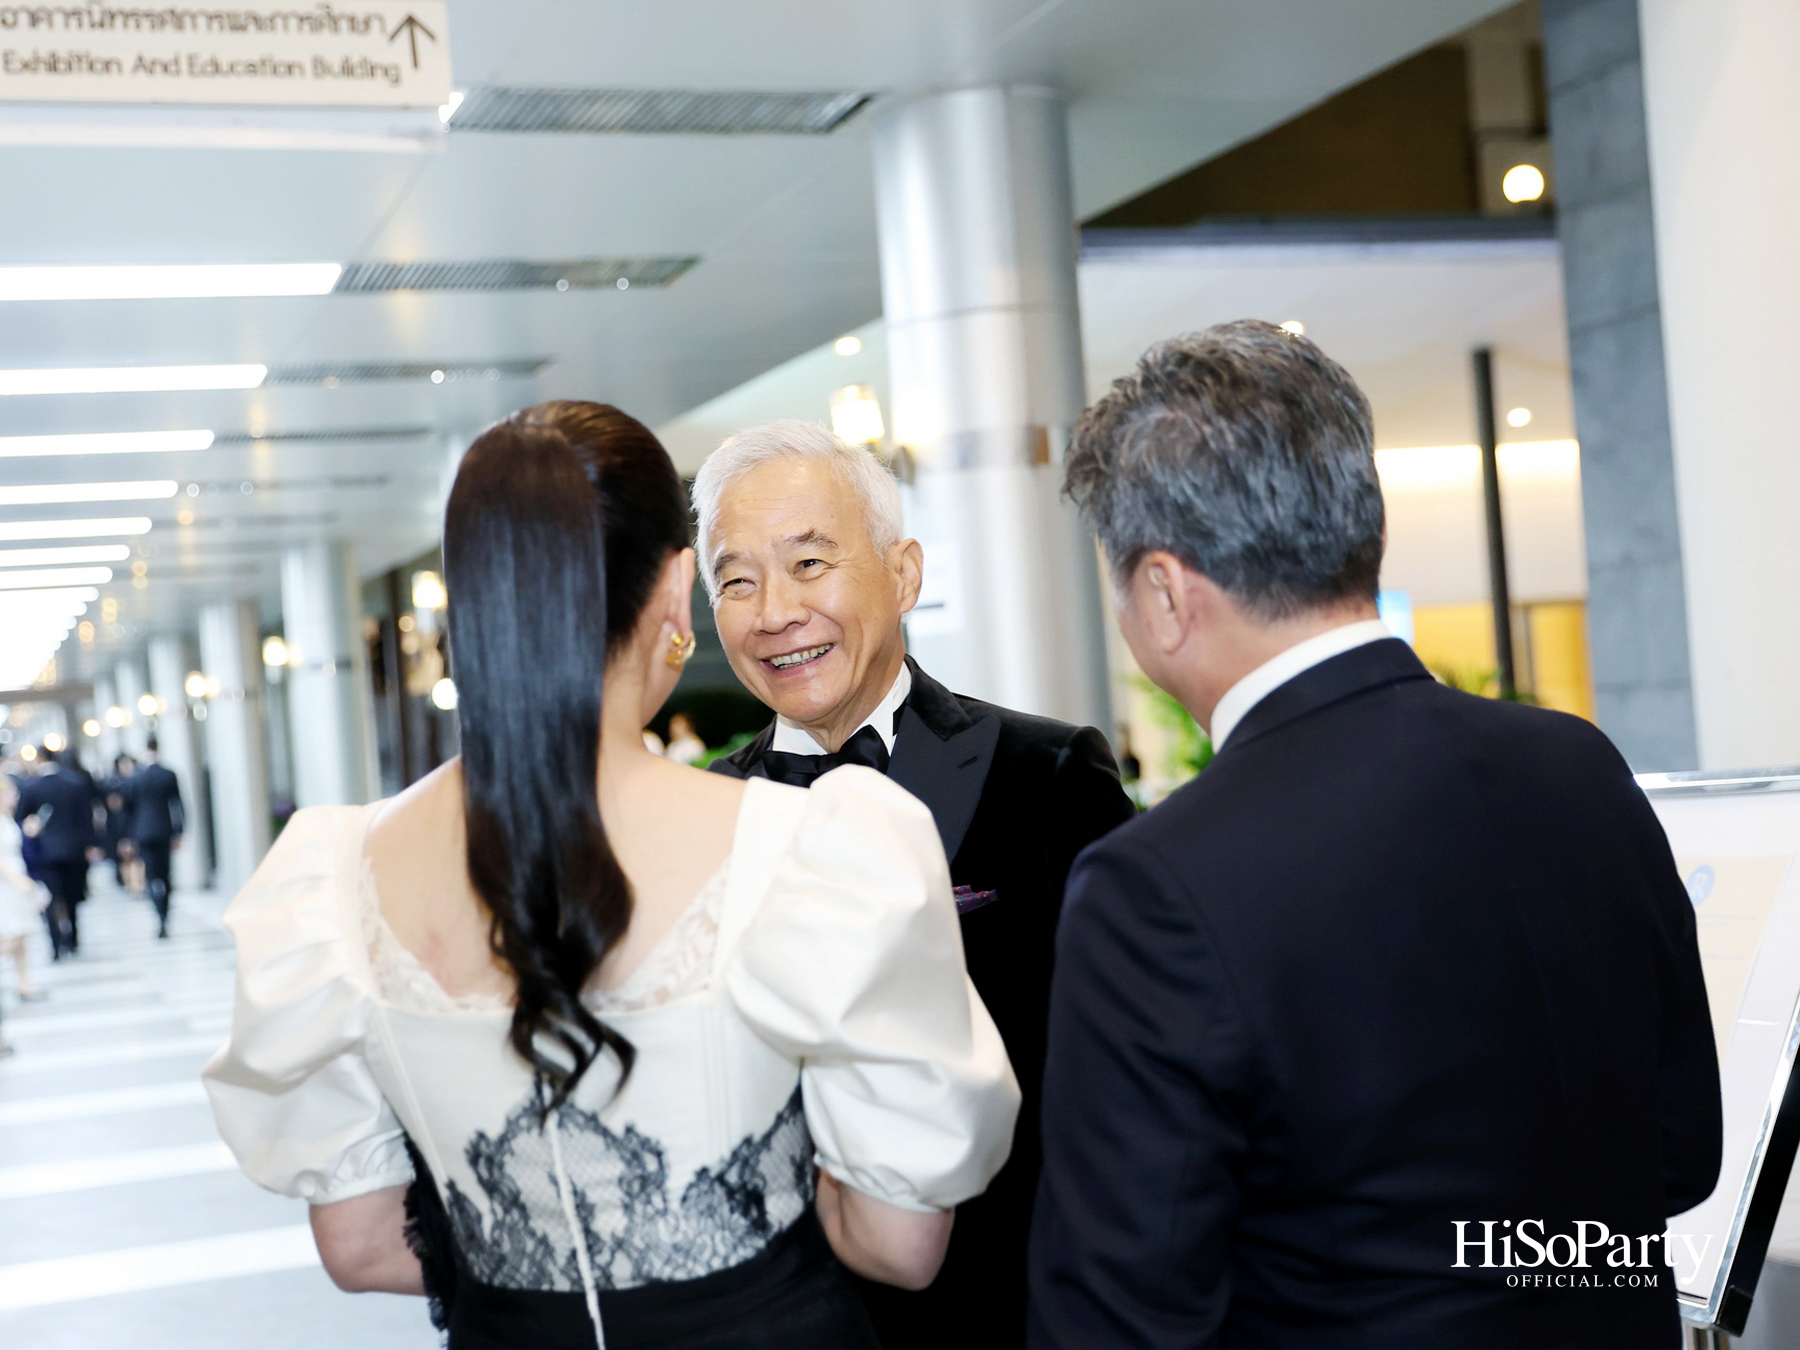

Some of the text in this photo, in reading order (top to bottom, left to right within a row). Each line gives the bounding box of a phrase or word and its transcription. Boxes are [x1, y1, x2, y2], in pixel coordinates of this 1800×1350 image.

[3, 50, 401, 86] Exhibition And Education Building
